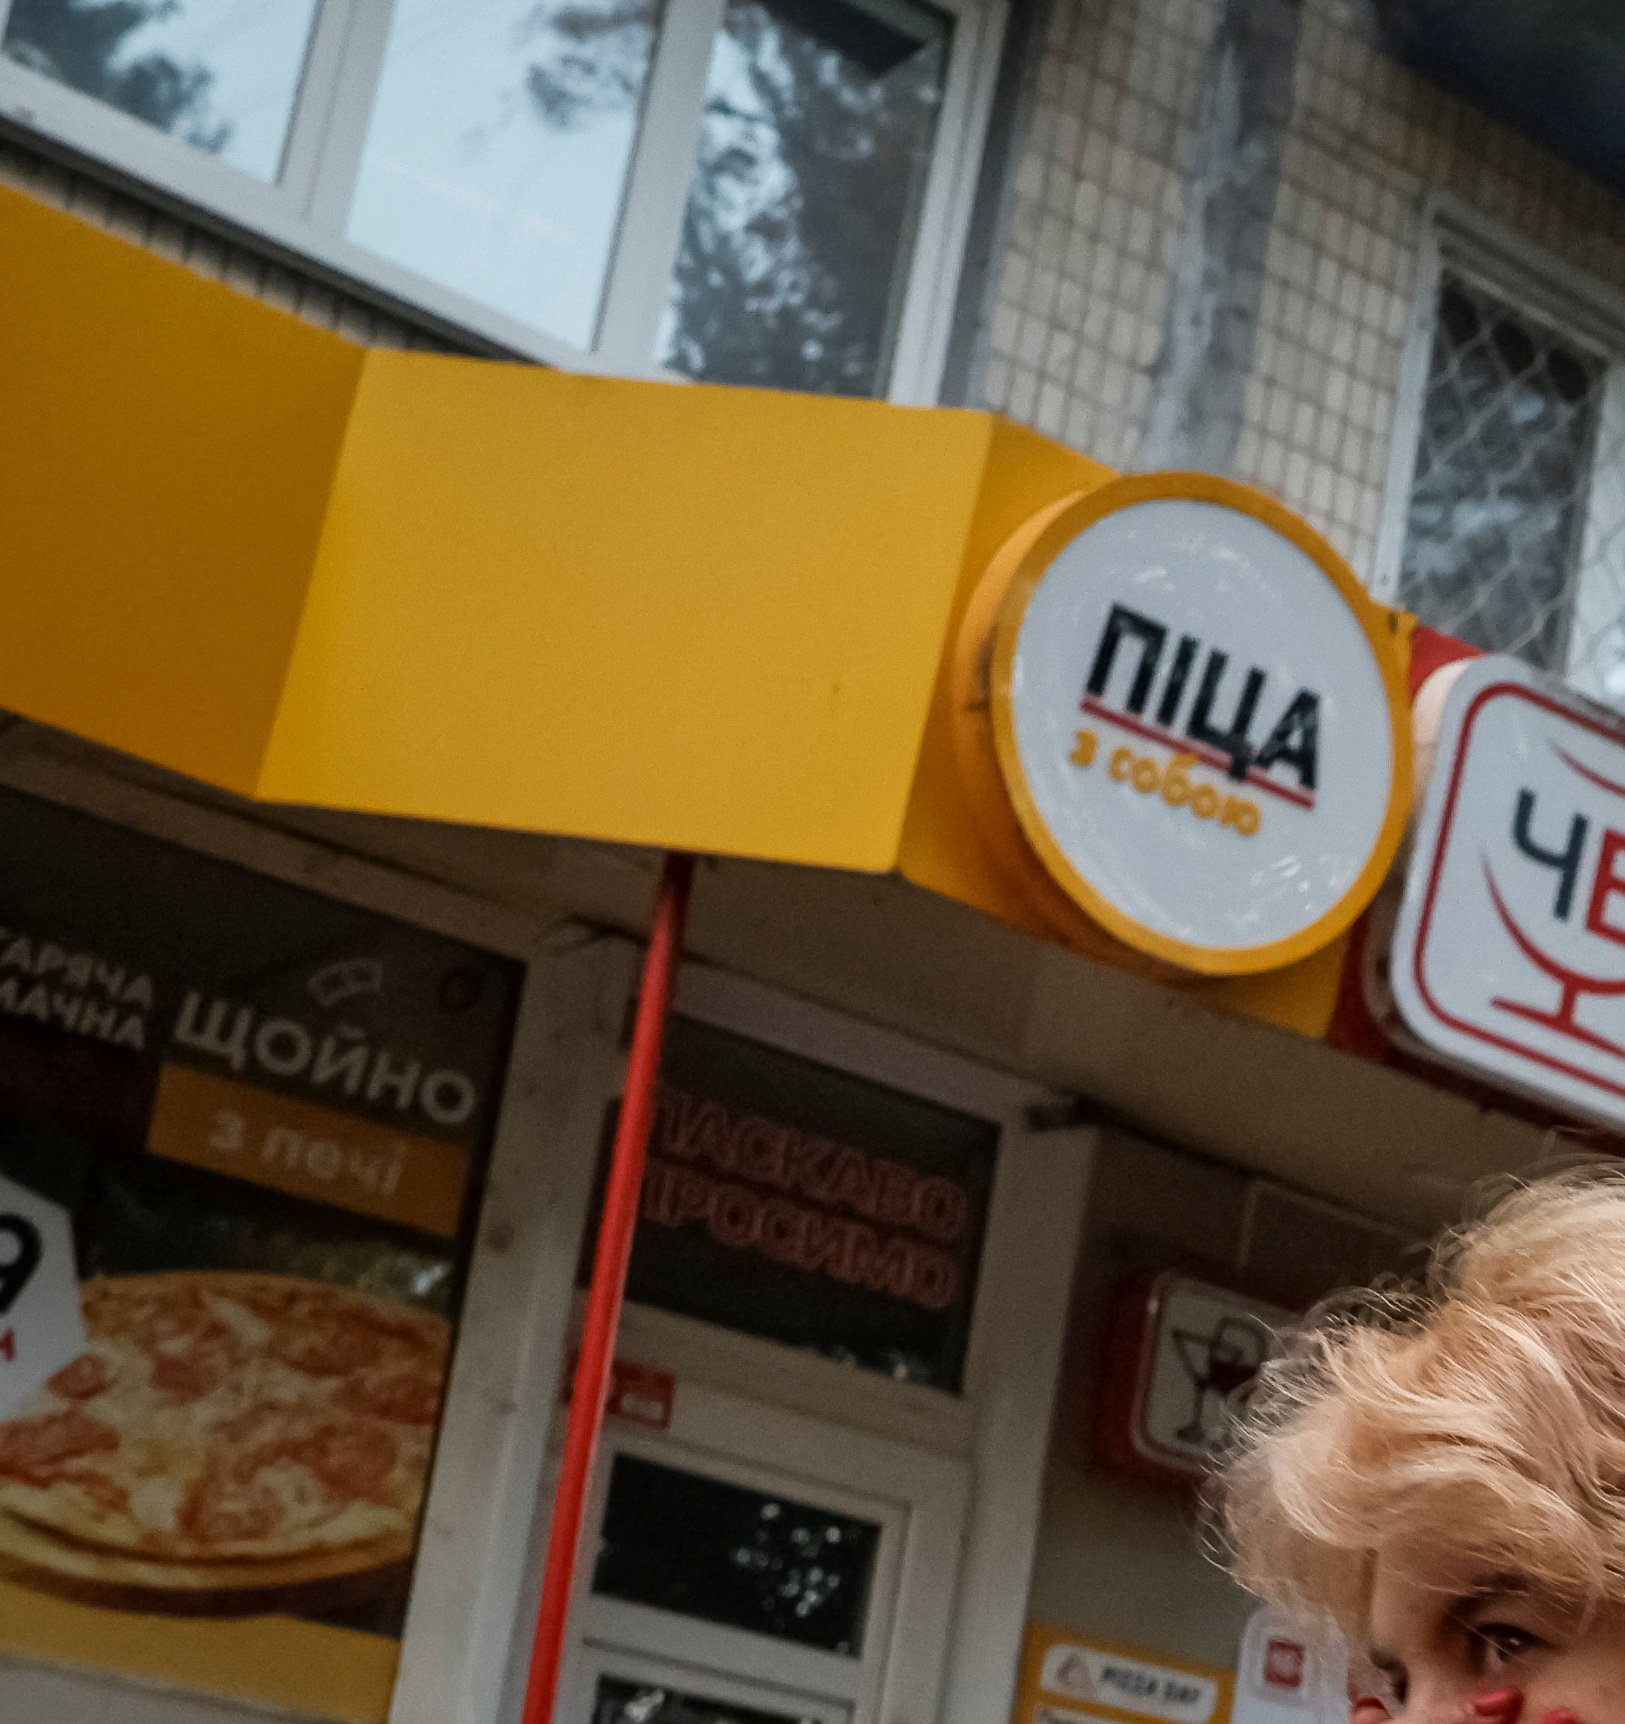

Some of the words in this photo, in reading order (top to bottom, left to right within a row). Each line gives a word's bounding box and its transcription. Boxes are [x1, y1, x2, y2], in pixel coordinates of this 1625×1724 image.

[1083, 601, 1321, 789] ПІЦА
[1067, 729, 1096, 768] з
[1108, 745, 1262, 837] собою
[0, 928, 153, 1011] АРЯЧА
[173, 990, 477, 1125] ЩОЙНО
[259, 1128, 402, 1197] печі
